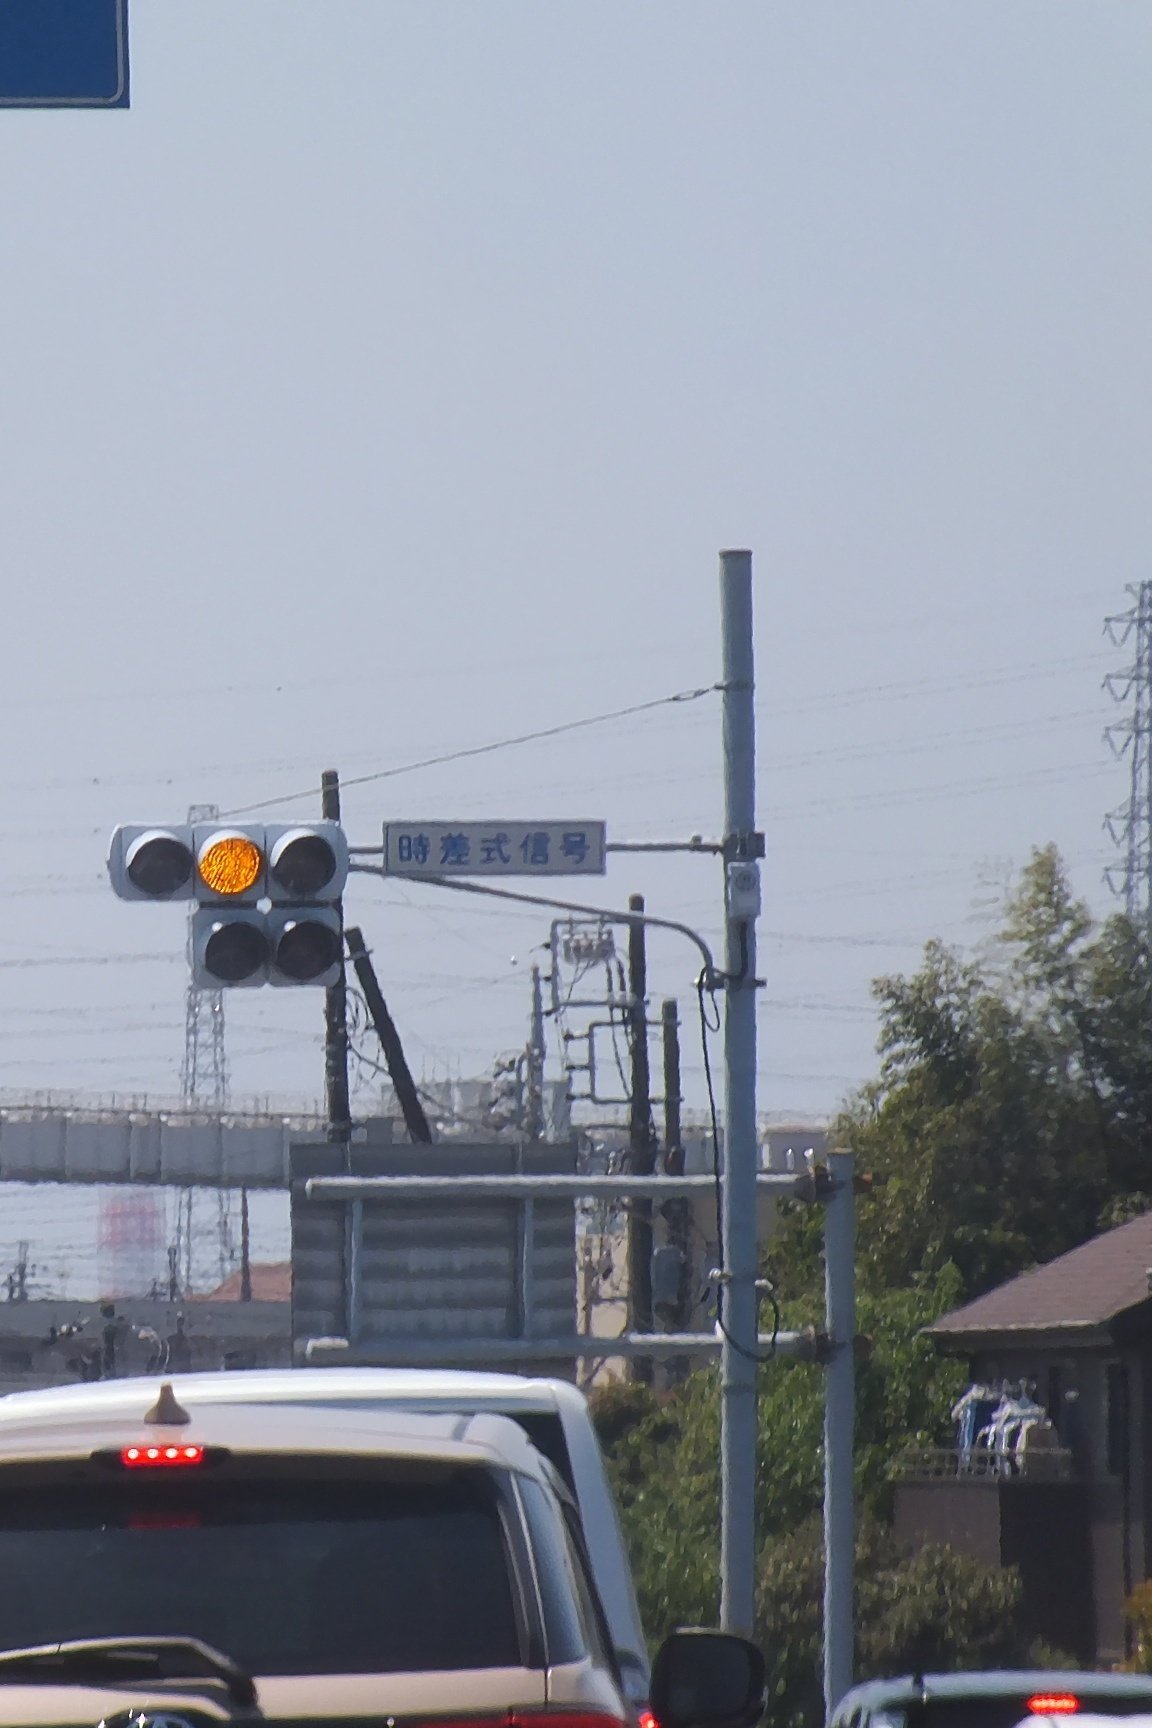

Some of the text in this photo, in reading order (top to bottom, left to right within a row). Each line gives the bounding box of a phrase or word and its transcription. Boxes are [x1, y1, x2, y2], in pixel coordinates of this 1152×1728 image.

[398, 831, 590, 865] 時差式信号
